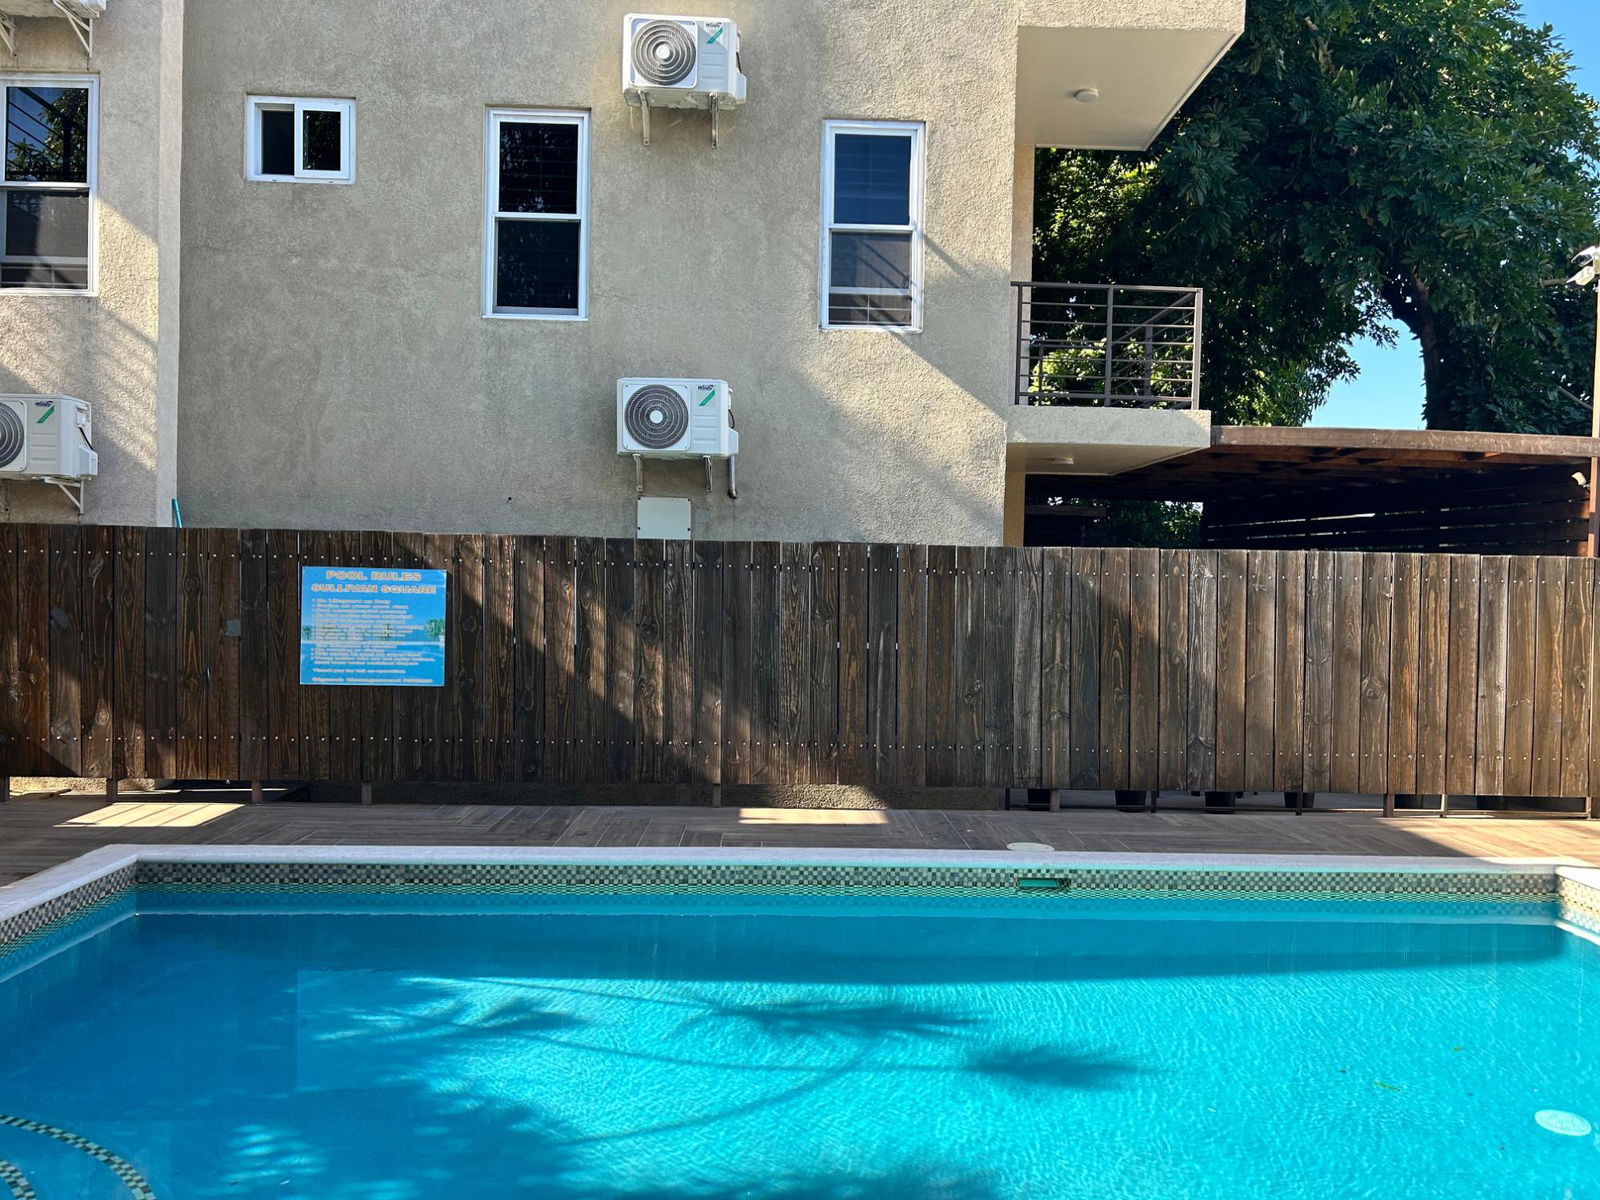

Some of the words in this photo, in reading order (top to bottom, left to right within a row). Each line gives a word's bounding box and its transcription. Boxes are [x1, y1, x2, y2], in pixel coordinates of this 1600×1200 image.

[325, 570, 368, 581] POOL
[371, 571, 422, 581] RULES
[311, 583, 378, 593] SULLIVAN
[381, 584, 437, 594] SQUARE
